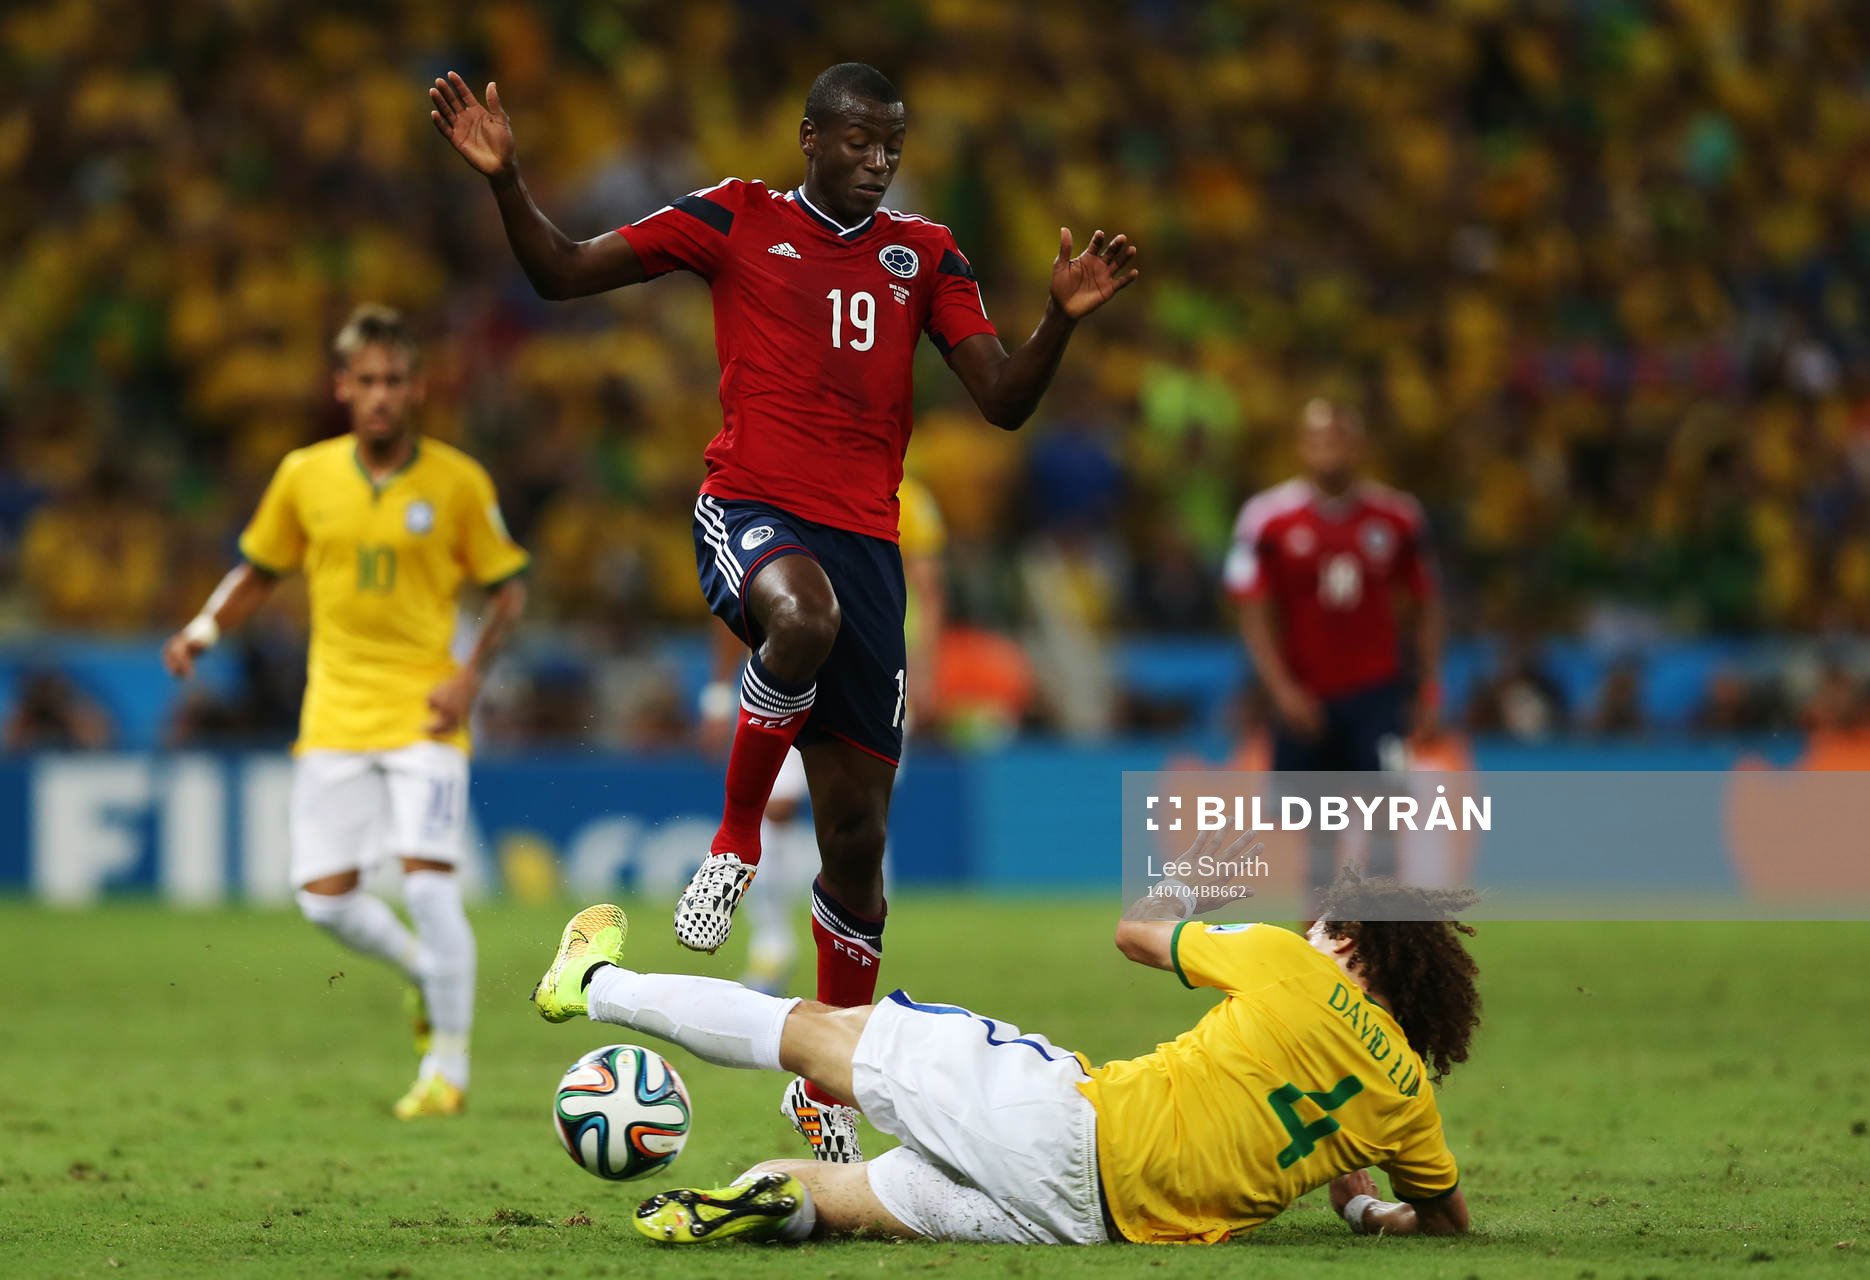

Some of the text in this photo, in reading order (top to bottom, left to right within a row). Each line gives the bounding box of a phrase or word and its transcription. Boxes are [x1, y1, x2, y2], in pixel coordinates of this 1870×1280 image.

[826, 288, 876, 351] 19
[357, 545, 397, 594] 10
[747, 716, 794, 729] FCF
[892, 669, 908, 728] 1
[833, 938, 872, 967] FCF
[1328, 982, 1391, 1061] DAVID
[1266, 1074, 1365, 1170] 4
